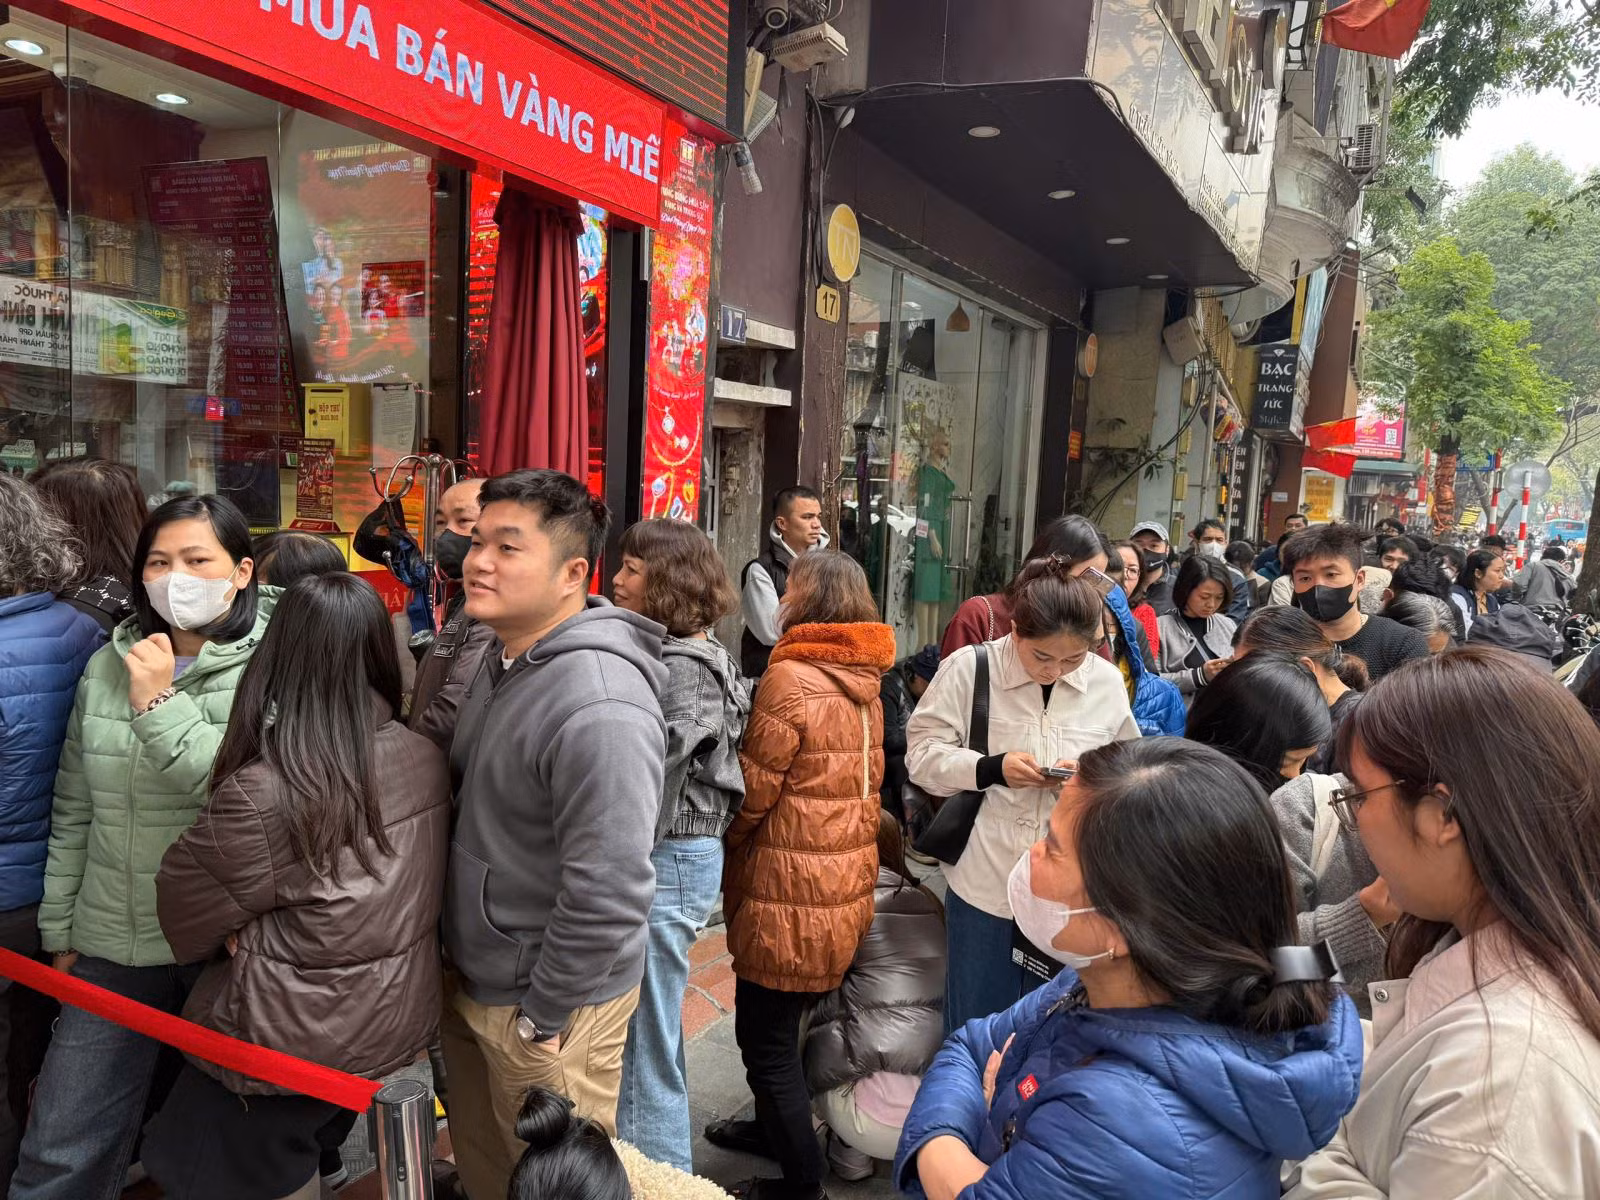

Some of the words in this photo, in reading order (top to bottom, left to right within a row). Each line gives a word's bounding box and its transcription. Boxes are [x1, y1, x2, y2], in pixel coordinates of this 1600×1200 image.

[396, 23, 483, 106] BÁN
[497, 70, 594, 154] VÀNG
[822, 291, 836, 316] 17
[727, 309, 743, 339] 17
[1261, 362, 1293, 379] BẠC
[1258, 383, 1293, 393] TRANG
[1263, 398, 1284, 409] SỨC
